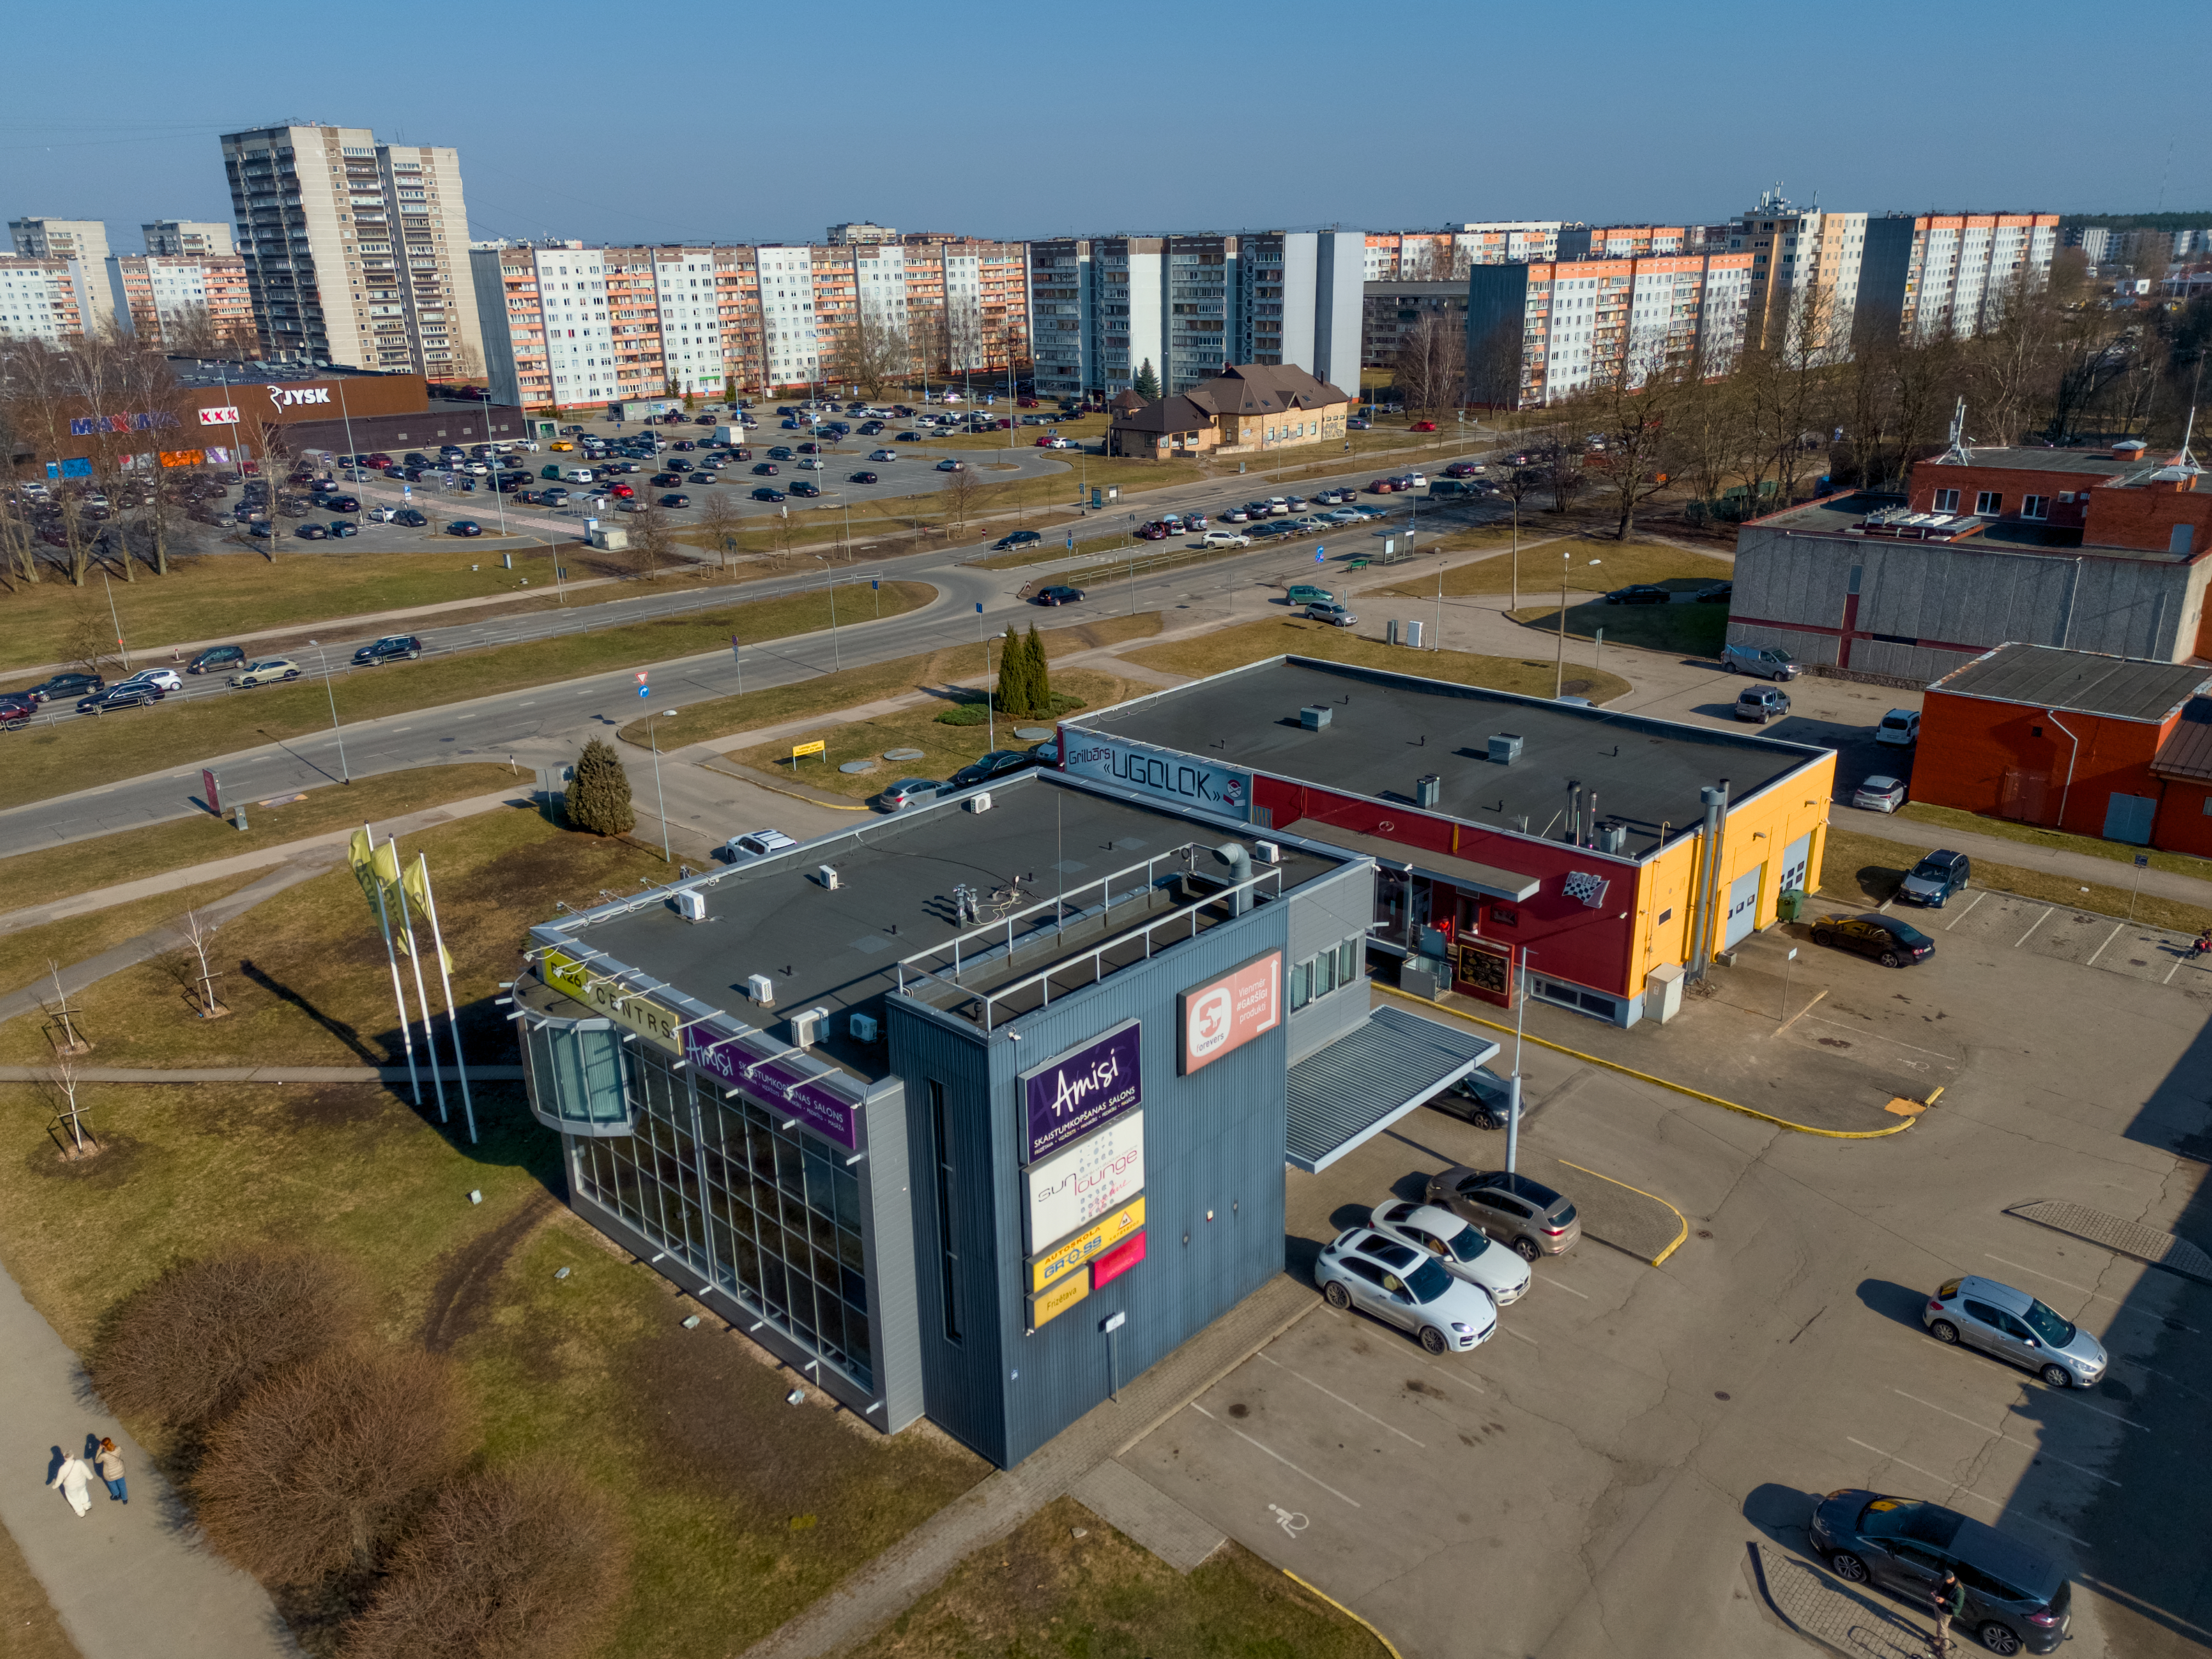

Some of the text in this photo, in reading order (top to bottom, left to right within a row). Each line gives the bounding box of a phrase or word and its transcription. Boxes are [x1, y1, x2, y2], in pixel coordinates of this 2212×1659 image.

[283, 388, 331, 405] JYSK
[70, 411, 181, 436] MAXIMA
[1069, 747, 1110, 765] Grilbārs
[1239, 978, 1266, 997] Vienmēr
[1237, 988, 1267, 1012] #GARŠĪGI
[596, 987, 673, 1040] CENTRS
[1239, 1002, 1266, 1024] produkti
[686, 1025, 733, 1076] Amisi
[1197, 1033, 1224, 1053] forevers
[1051, 1048, 1119, 1117] Amisi
[814, 1100, 843, 1123] SALONS
[1034, 1086, 1135, 1148] SKAISTUMKOPŠANAS SALONS
[1045, 1226, 1101, 1265] AUTOSKOLA
[1045, 1235, 1102, 1279] GROSS
[1047, 1288, 1076, 1311] Frizētava
